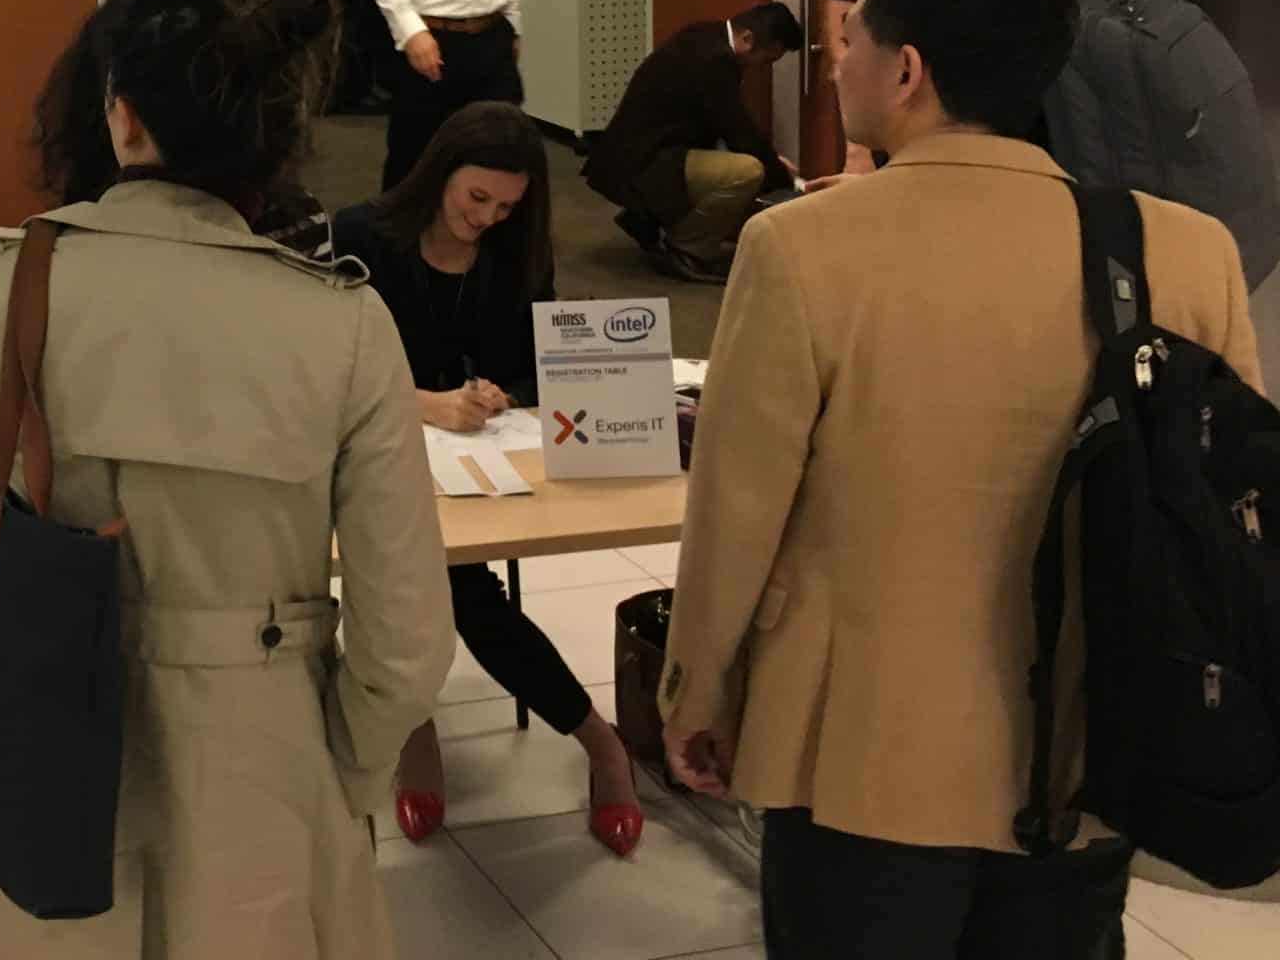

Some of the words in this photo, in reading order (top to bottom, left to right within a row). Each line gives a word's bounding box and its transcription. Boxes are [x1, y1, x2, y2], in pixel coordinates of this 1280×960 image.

[610, 315, 648, 332] intel
[545, 368, 602, 377] REGISTRATION
[604, 367, 628, 375] TABLE
[595, 419, 648, 435] Experis
[651, 416, 665, 431] IT
